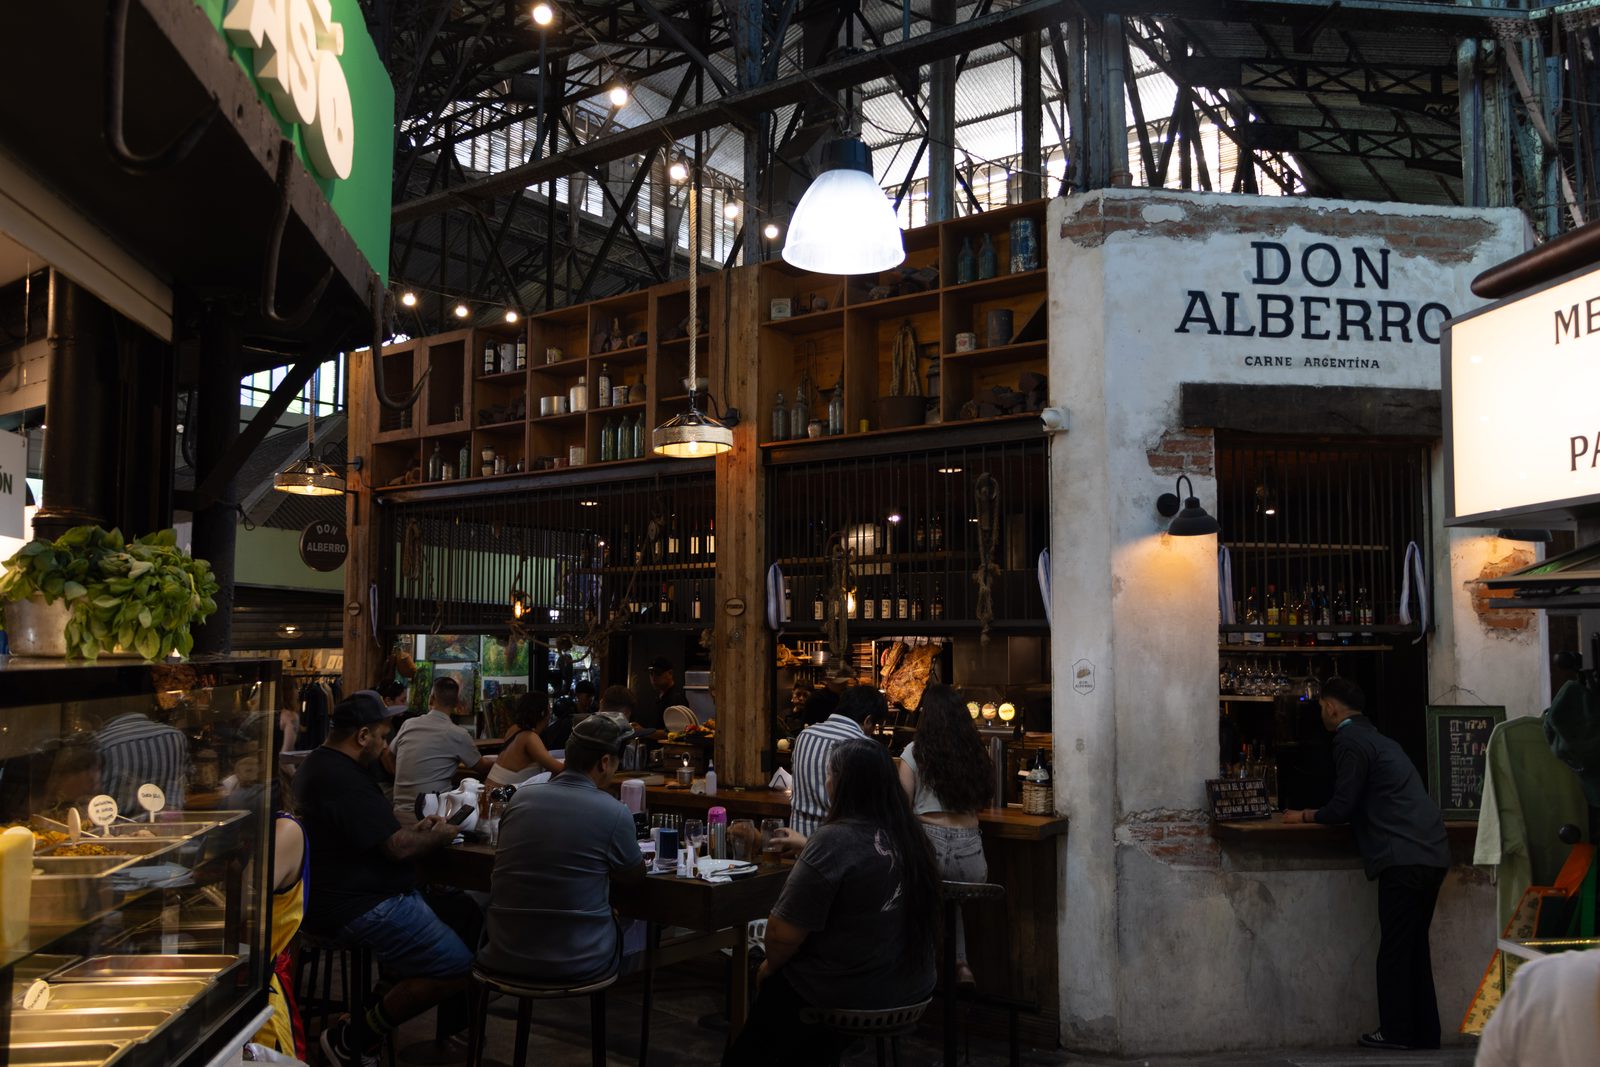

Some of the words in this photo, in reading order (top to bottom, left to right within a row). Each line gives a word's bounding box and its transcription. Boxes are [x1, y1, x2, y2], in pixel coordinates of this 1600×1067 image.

[1250, 241, 1391, 290] DON
[1174, 290, 1453, 345] ALBERRO
[1244, 355, 1293, 367] CARNE
[316, 523, 339, 536] DON
[306, 541, 347, 554] ALBERRO
